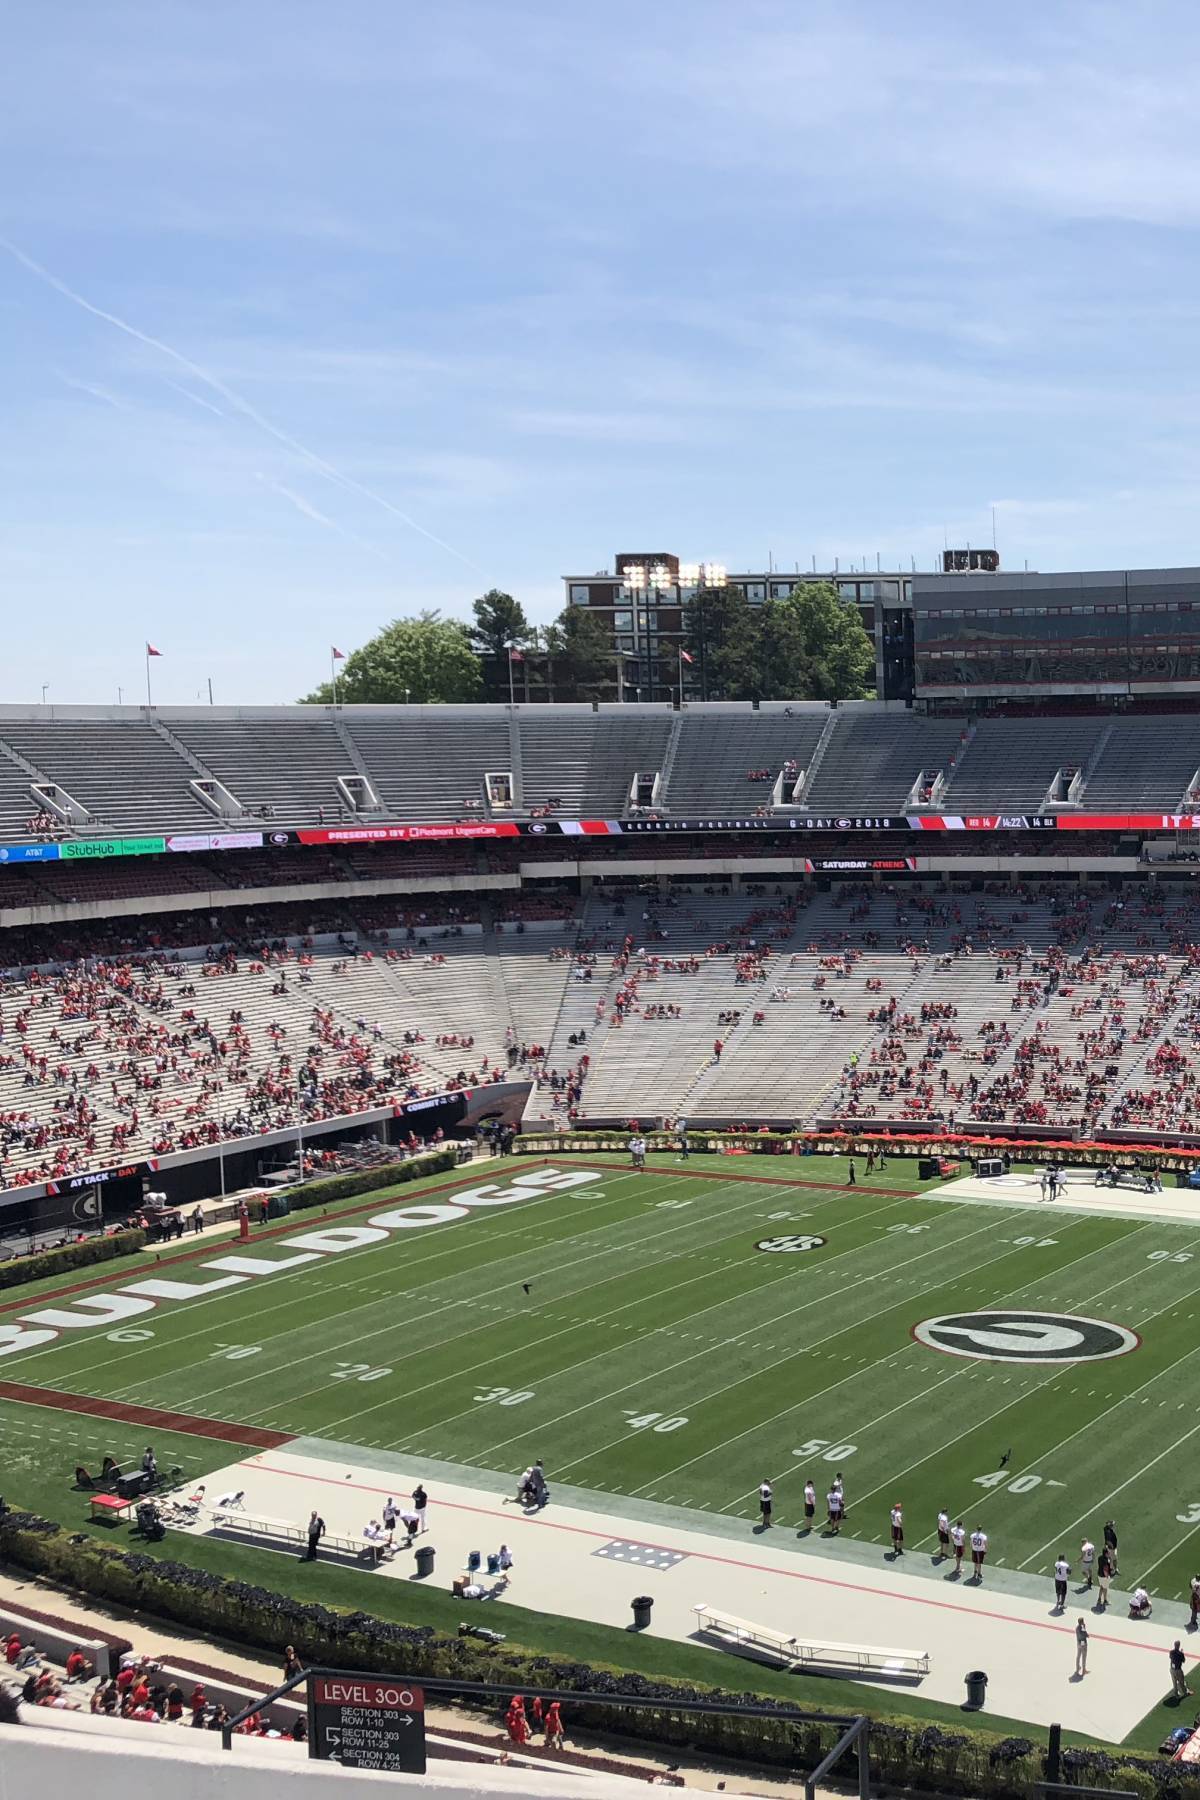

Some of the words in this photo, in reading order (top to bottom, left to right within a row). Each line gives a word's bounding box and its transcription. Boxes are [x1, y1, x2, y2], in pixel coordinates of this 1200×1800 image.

[855, 818, 890, 828] 2018
[1002, 817, 1022, 827] 14:22
[328, 831, 386, 840] PRESENTED
[67, 843, 115, 857] StubHub
[822, 861, 867, 869] SATURDAY
[70, 1172, 109, 1188] ATTACK
[118, 1167, 138, 1177] DAY
[329, 1364, 394, 1382] 20
[472, 1386, 536, 1406] 30
[624, 1412, 690, 1433] 40
[791, 1439, 858, 1461] 50
[971, 1470, 1043, 1493] 40
[324, 1684, 371, 1703] LEVEL
[375, 1688, 414, 1706] 300
[340, 1706, 382, 1719] SECTION
[382, 1709, 399, 1720] 303
[341, 1716, 364, 1726] ROW
[366, 1718, 385, 1728] 1-10
[341, 1727, 382, 1740] SECTION
[383, 1731, 400, 1742] 303
[342, 1737, 365, 1747] ROW
[366, 1739, 390, 1749] 11-25
[342, 1749, 383, 1760] SECTION
[384, 1751, 400, 1762] 304
[357, 1758, 381, 1769] ROW
[381, 1760, 401, 1770] 4-25
